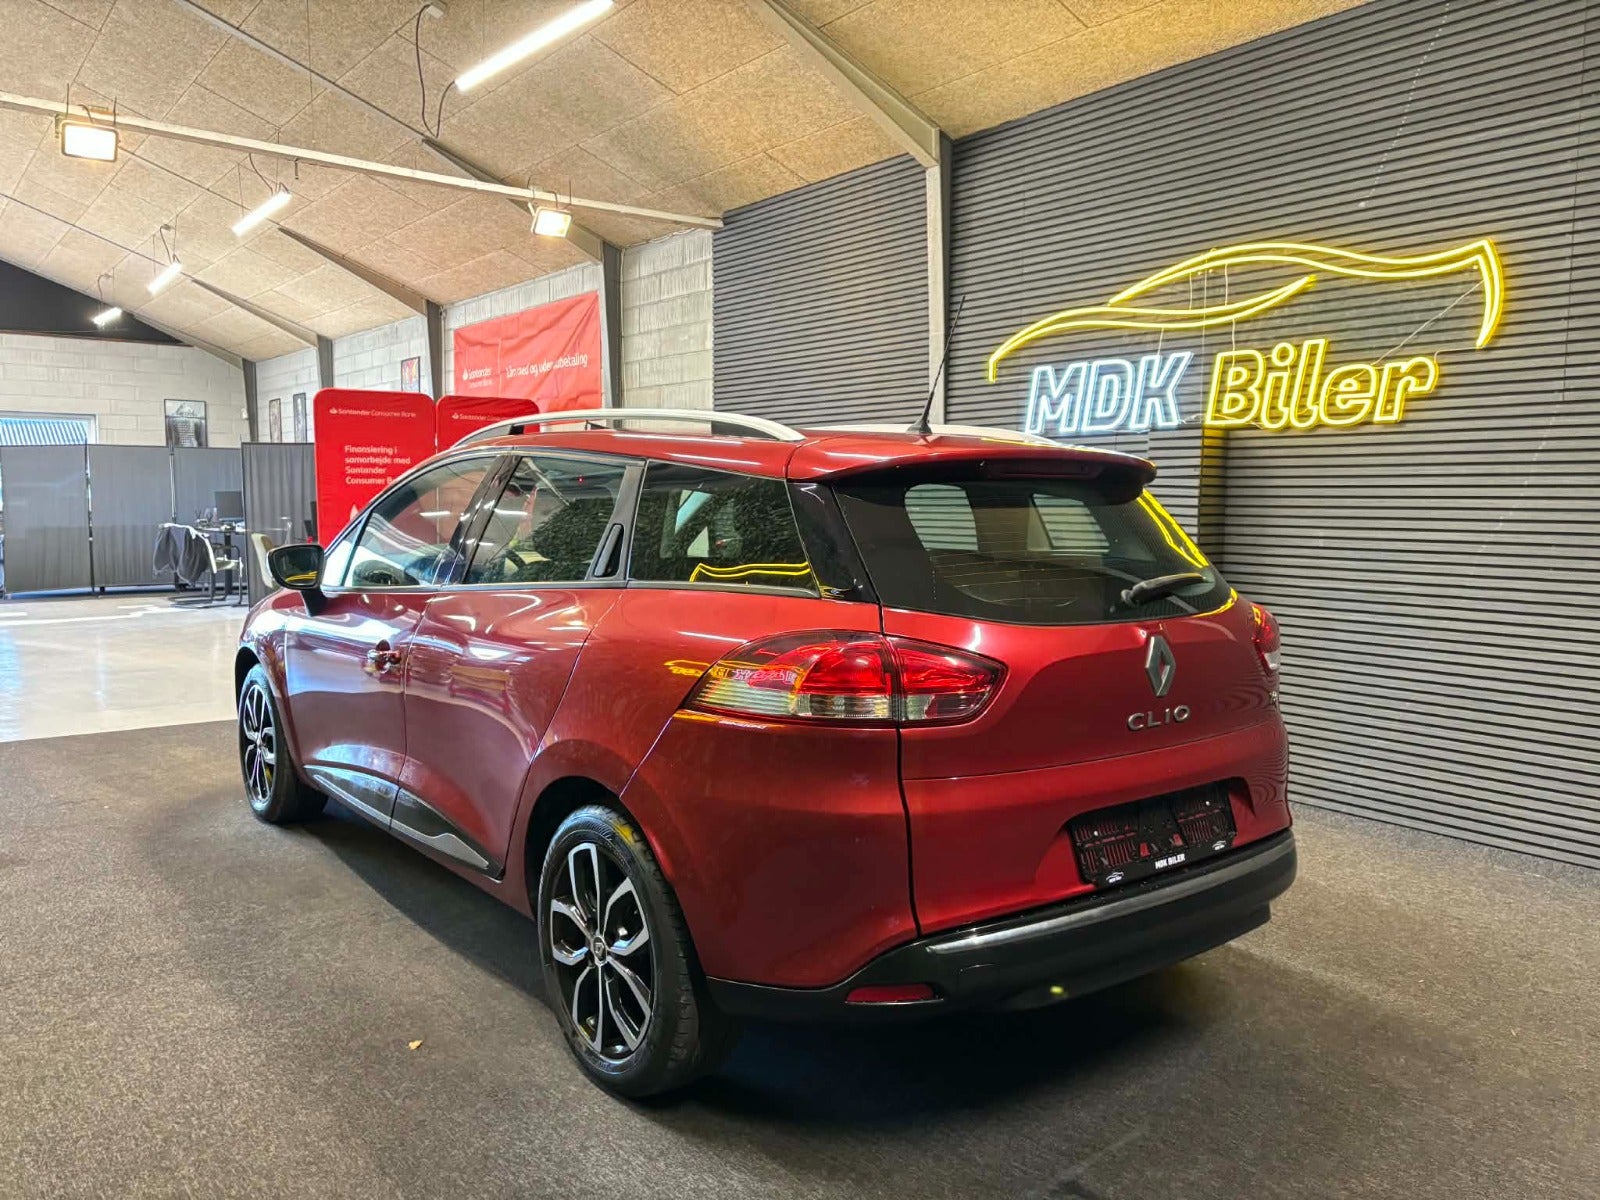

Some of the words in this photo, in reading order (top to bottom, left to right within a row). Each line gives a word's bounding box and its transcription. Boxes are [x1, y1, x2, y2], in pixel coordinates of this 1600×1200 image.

[1025, 350, 1194, 435] MDK
[1204, 337, 1439, 430] Biler
[338, 408, 370, 417] Santander
[344, 444, 394, 456] Finansiering
[344, 456, 392, 466] samarbejde
[393, 456, 412, 465] med
[345, 465, 387, 474] Santander
[345, 475, 386, 485] Consumer
[1126, 704, 1191, 731] CLIO
